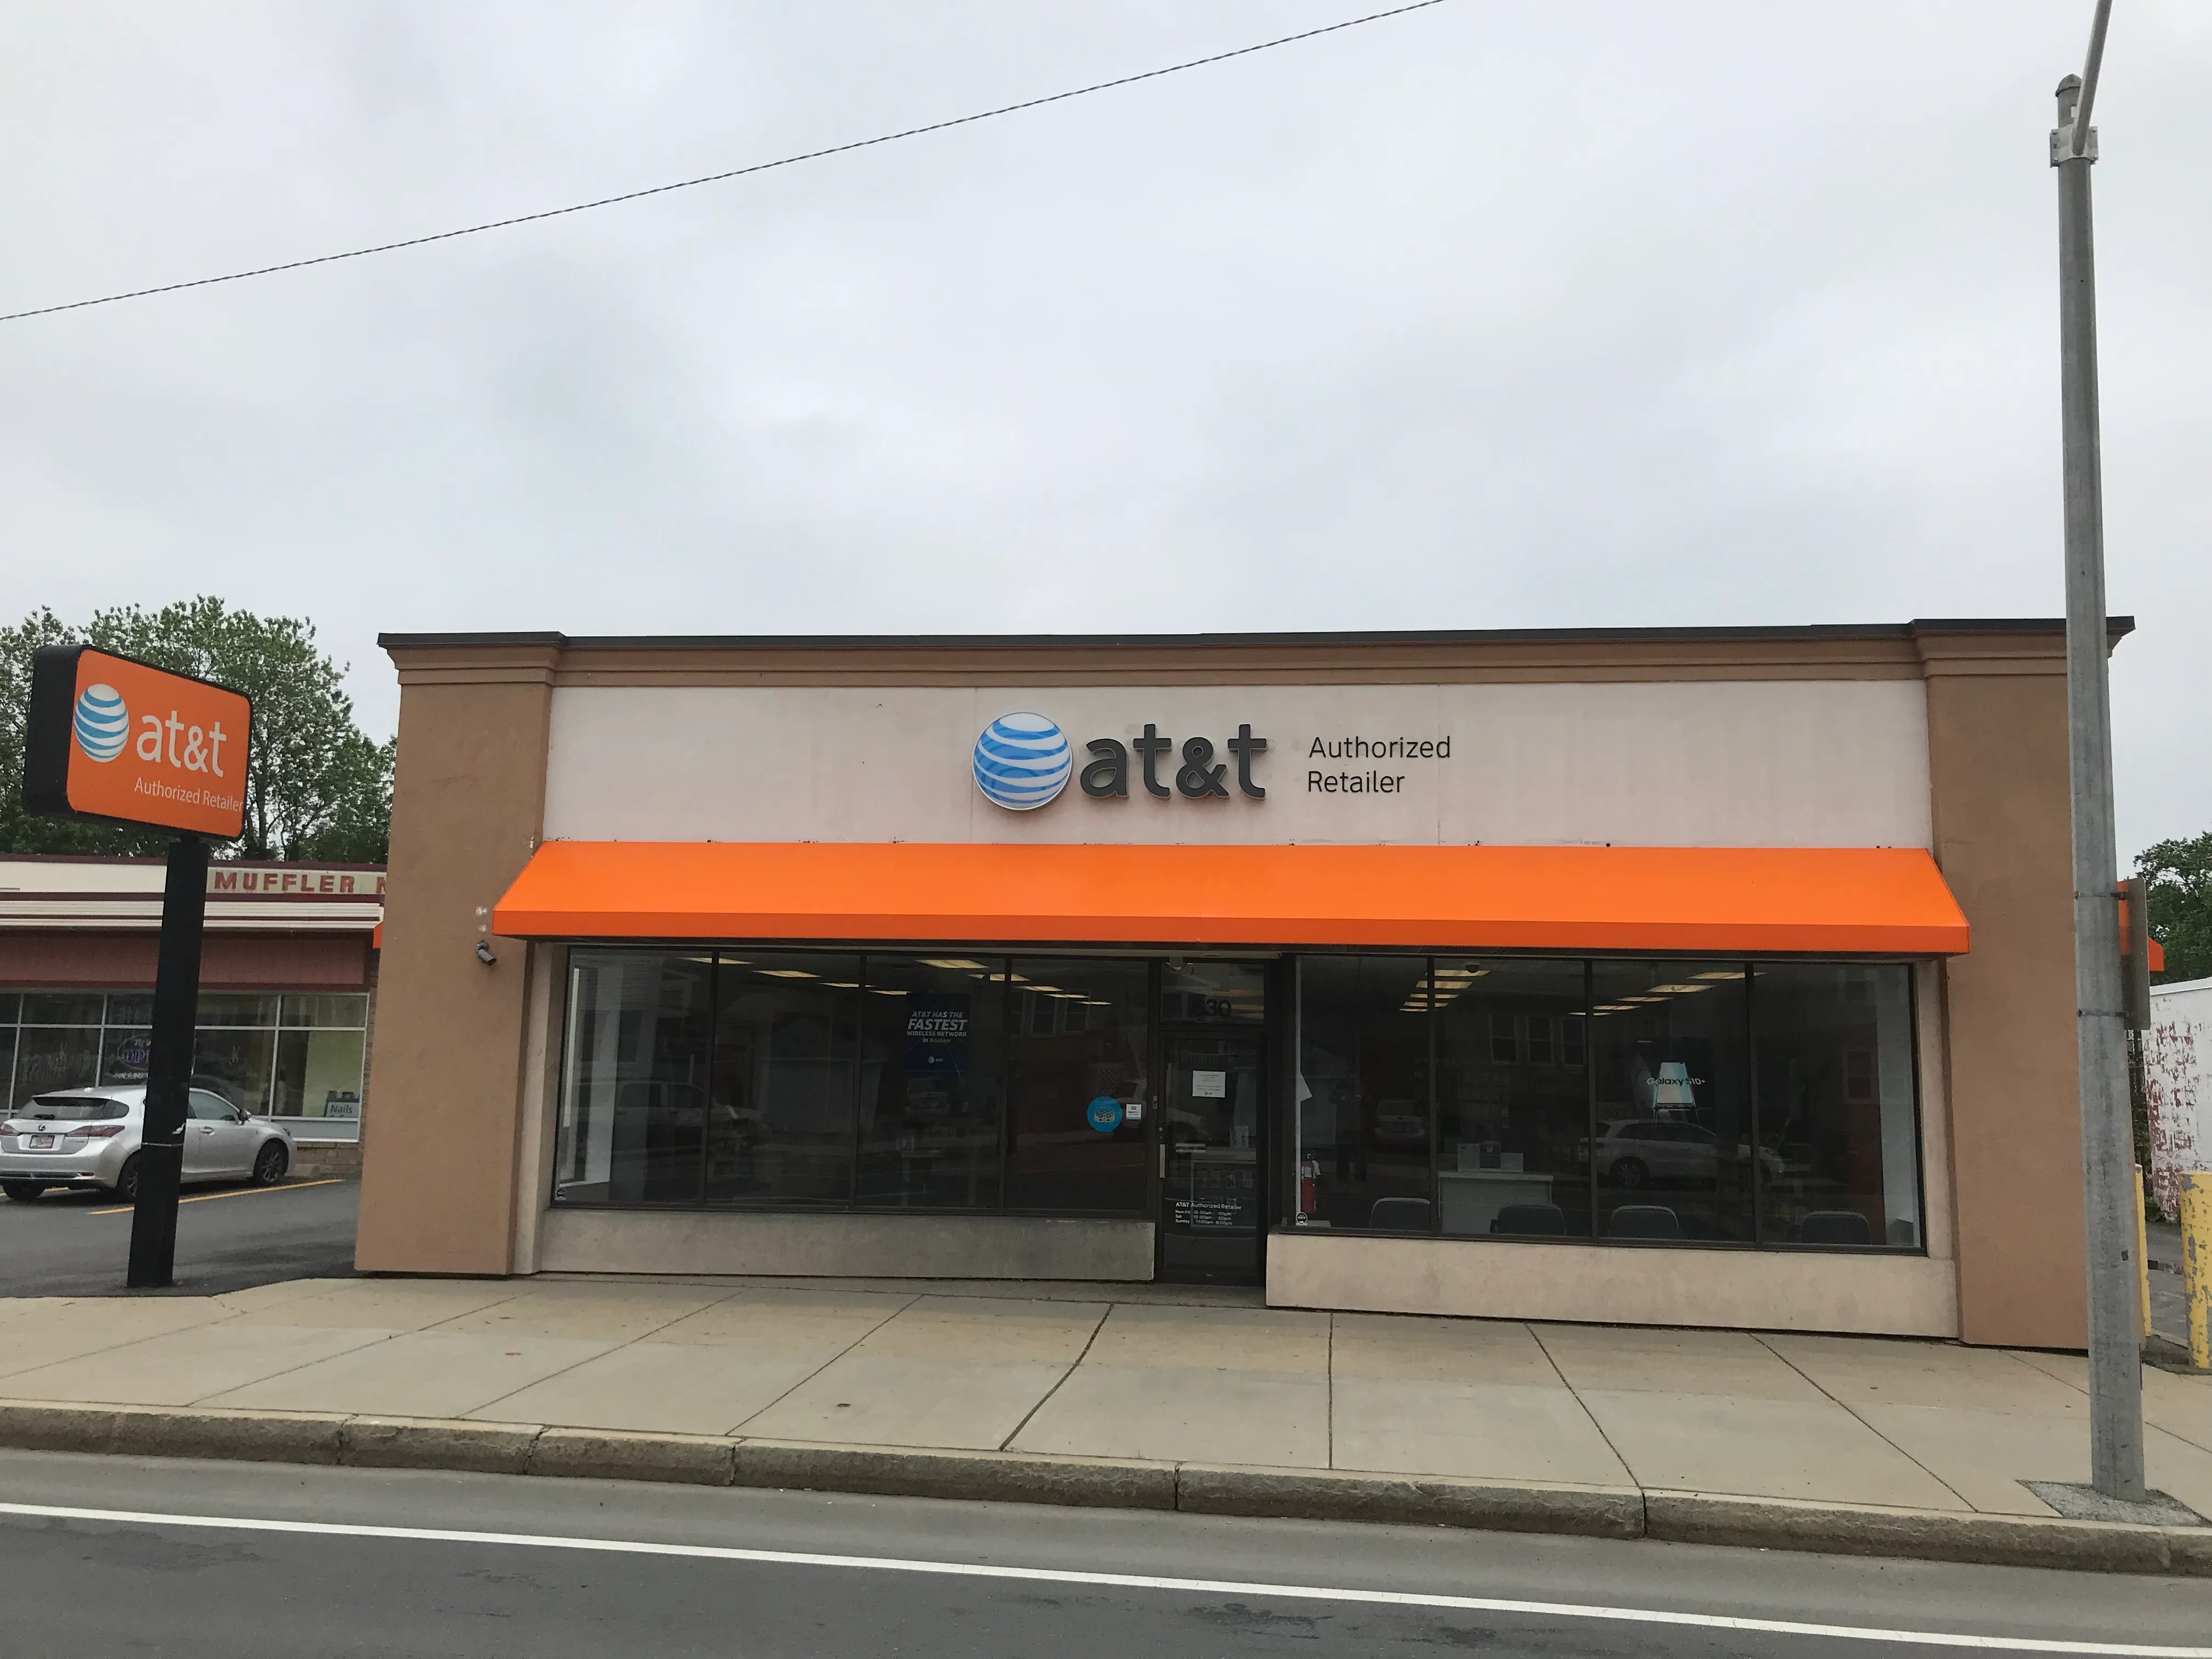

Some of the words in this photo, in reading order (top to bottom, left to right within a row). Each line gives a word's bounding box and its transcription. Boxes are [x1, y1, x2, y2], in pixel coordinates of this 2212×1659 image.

[137, 710, 227, 778] at&t
[1309, 736, 1451, 759] Authorized
[1080, 724, 1267, 800] at&t
[1308, 771, 1406, 793] Retailer
[134, 776, 201, 804] Authorized
[202, 789, 244, 812] Retailer
[215, 871, 356, 893] MUFFLER
[907, 1019, 968, 1031] FASTEST
[1646, 1077, 1683, 1087] Galaxy
[331, 1104, 353, 1114] Nails
